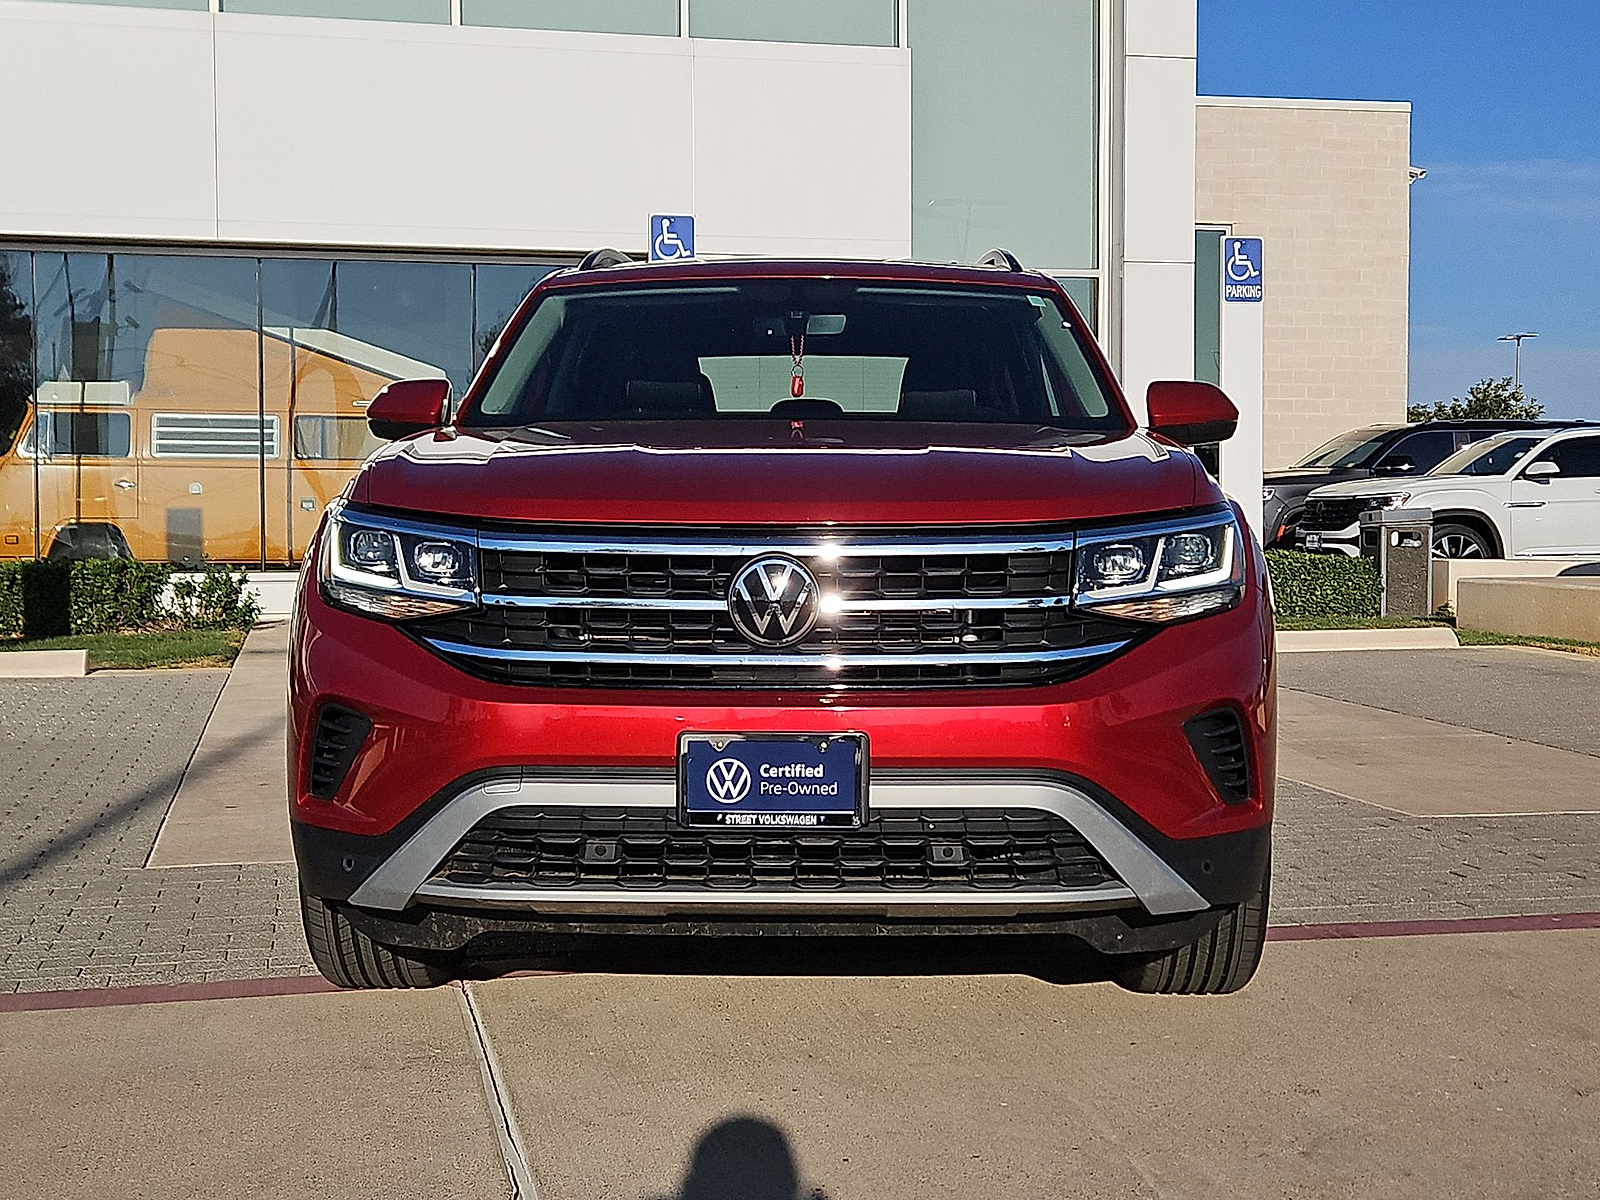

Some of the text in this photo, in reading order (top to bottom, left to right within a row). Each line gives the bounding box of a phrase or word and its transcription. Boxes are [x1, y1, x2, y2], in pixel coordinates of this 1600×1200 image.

[1226, 285, 1261, 298] PARKING
[760, 763, 824, 778] Certified
[760, 781, 838, 795] Pre-Owned
[725, 814, 817, 825] STREET VOLKSWAGEN
